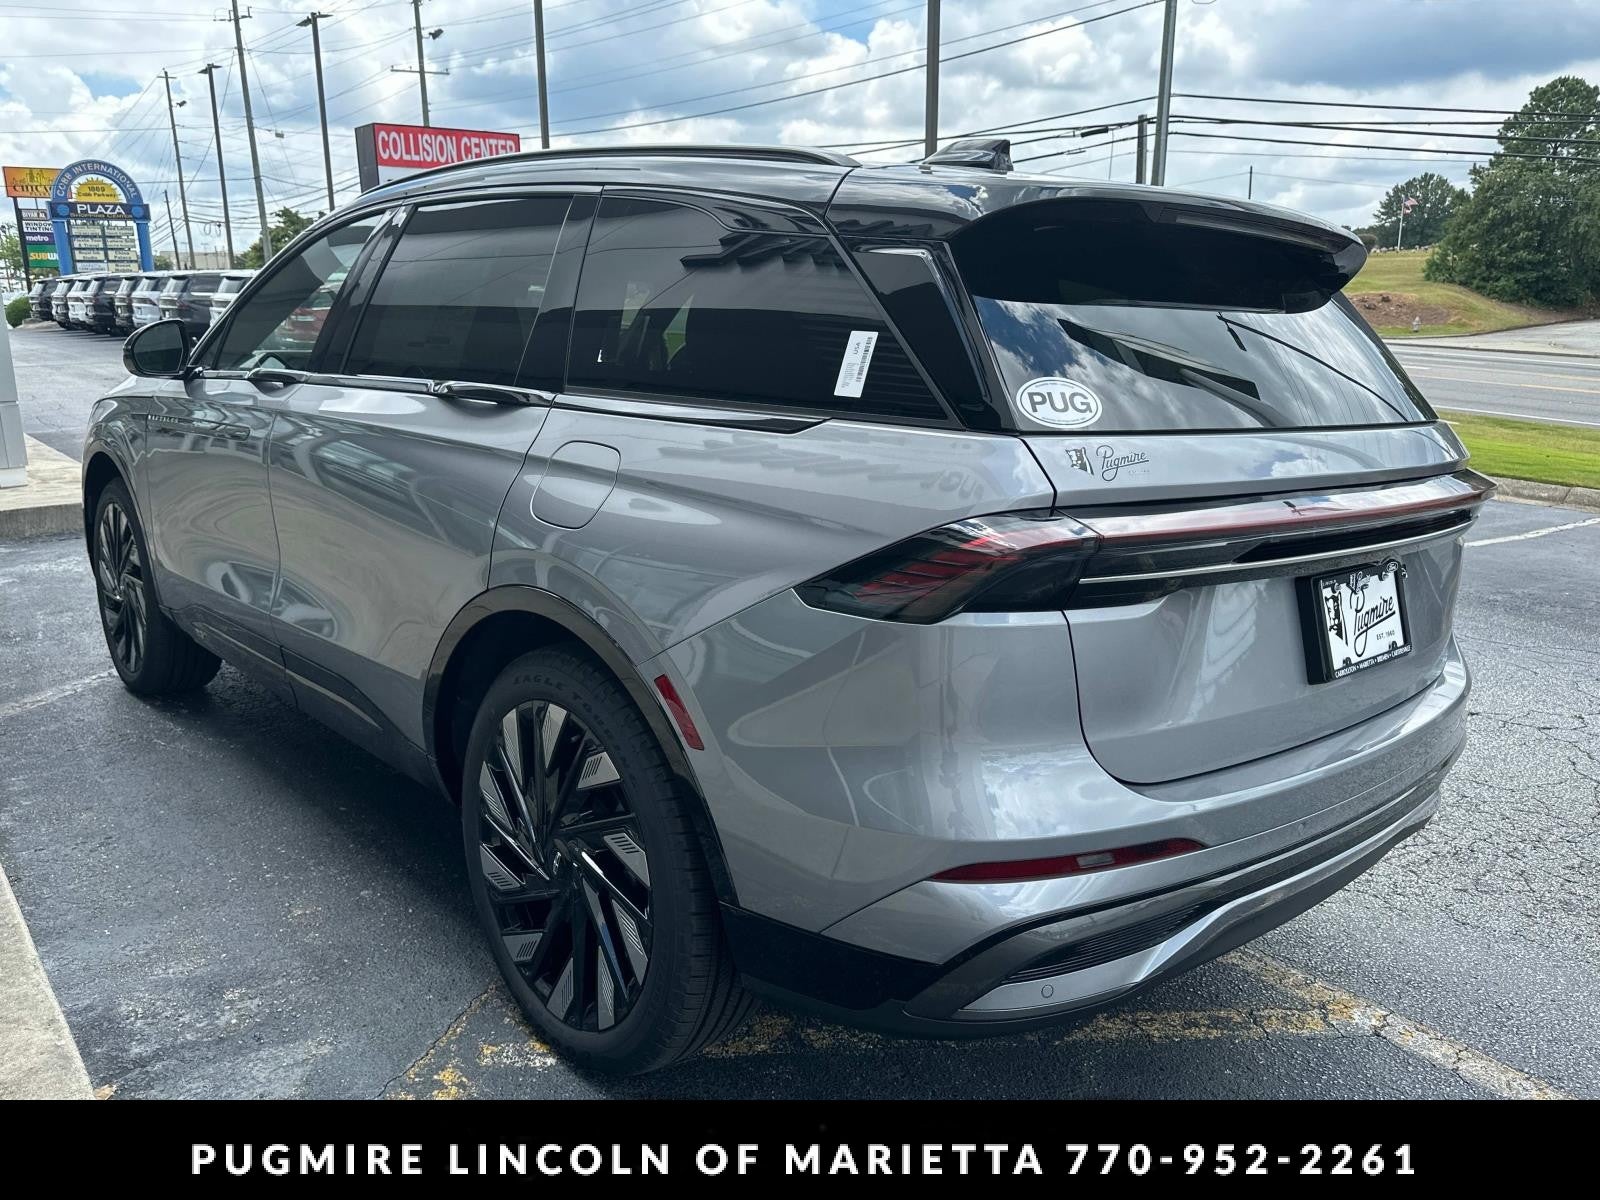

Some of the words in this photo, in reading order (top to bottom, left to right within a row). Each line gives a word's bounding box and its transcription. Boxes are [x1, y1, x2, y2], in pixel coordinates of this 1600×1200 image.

[378, 130, 457, 163] COLLISION
[56, 172, 73, 197] COBB
[73, 163, 138, 198] INTERNATIONAL
[77, 204, 125, 215] PLAZA
[30, 252, 58, 260] SUBW
[1027, 391, 1093, 414] PUG
[1096, 444, 1150, 482] Pugmire
[1350, 588, 1396, 657] Pugmire
